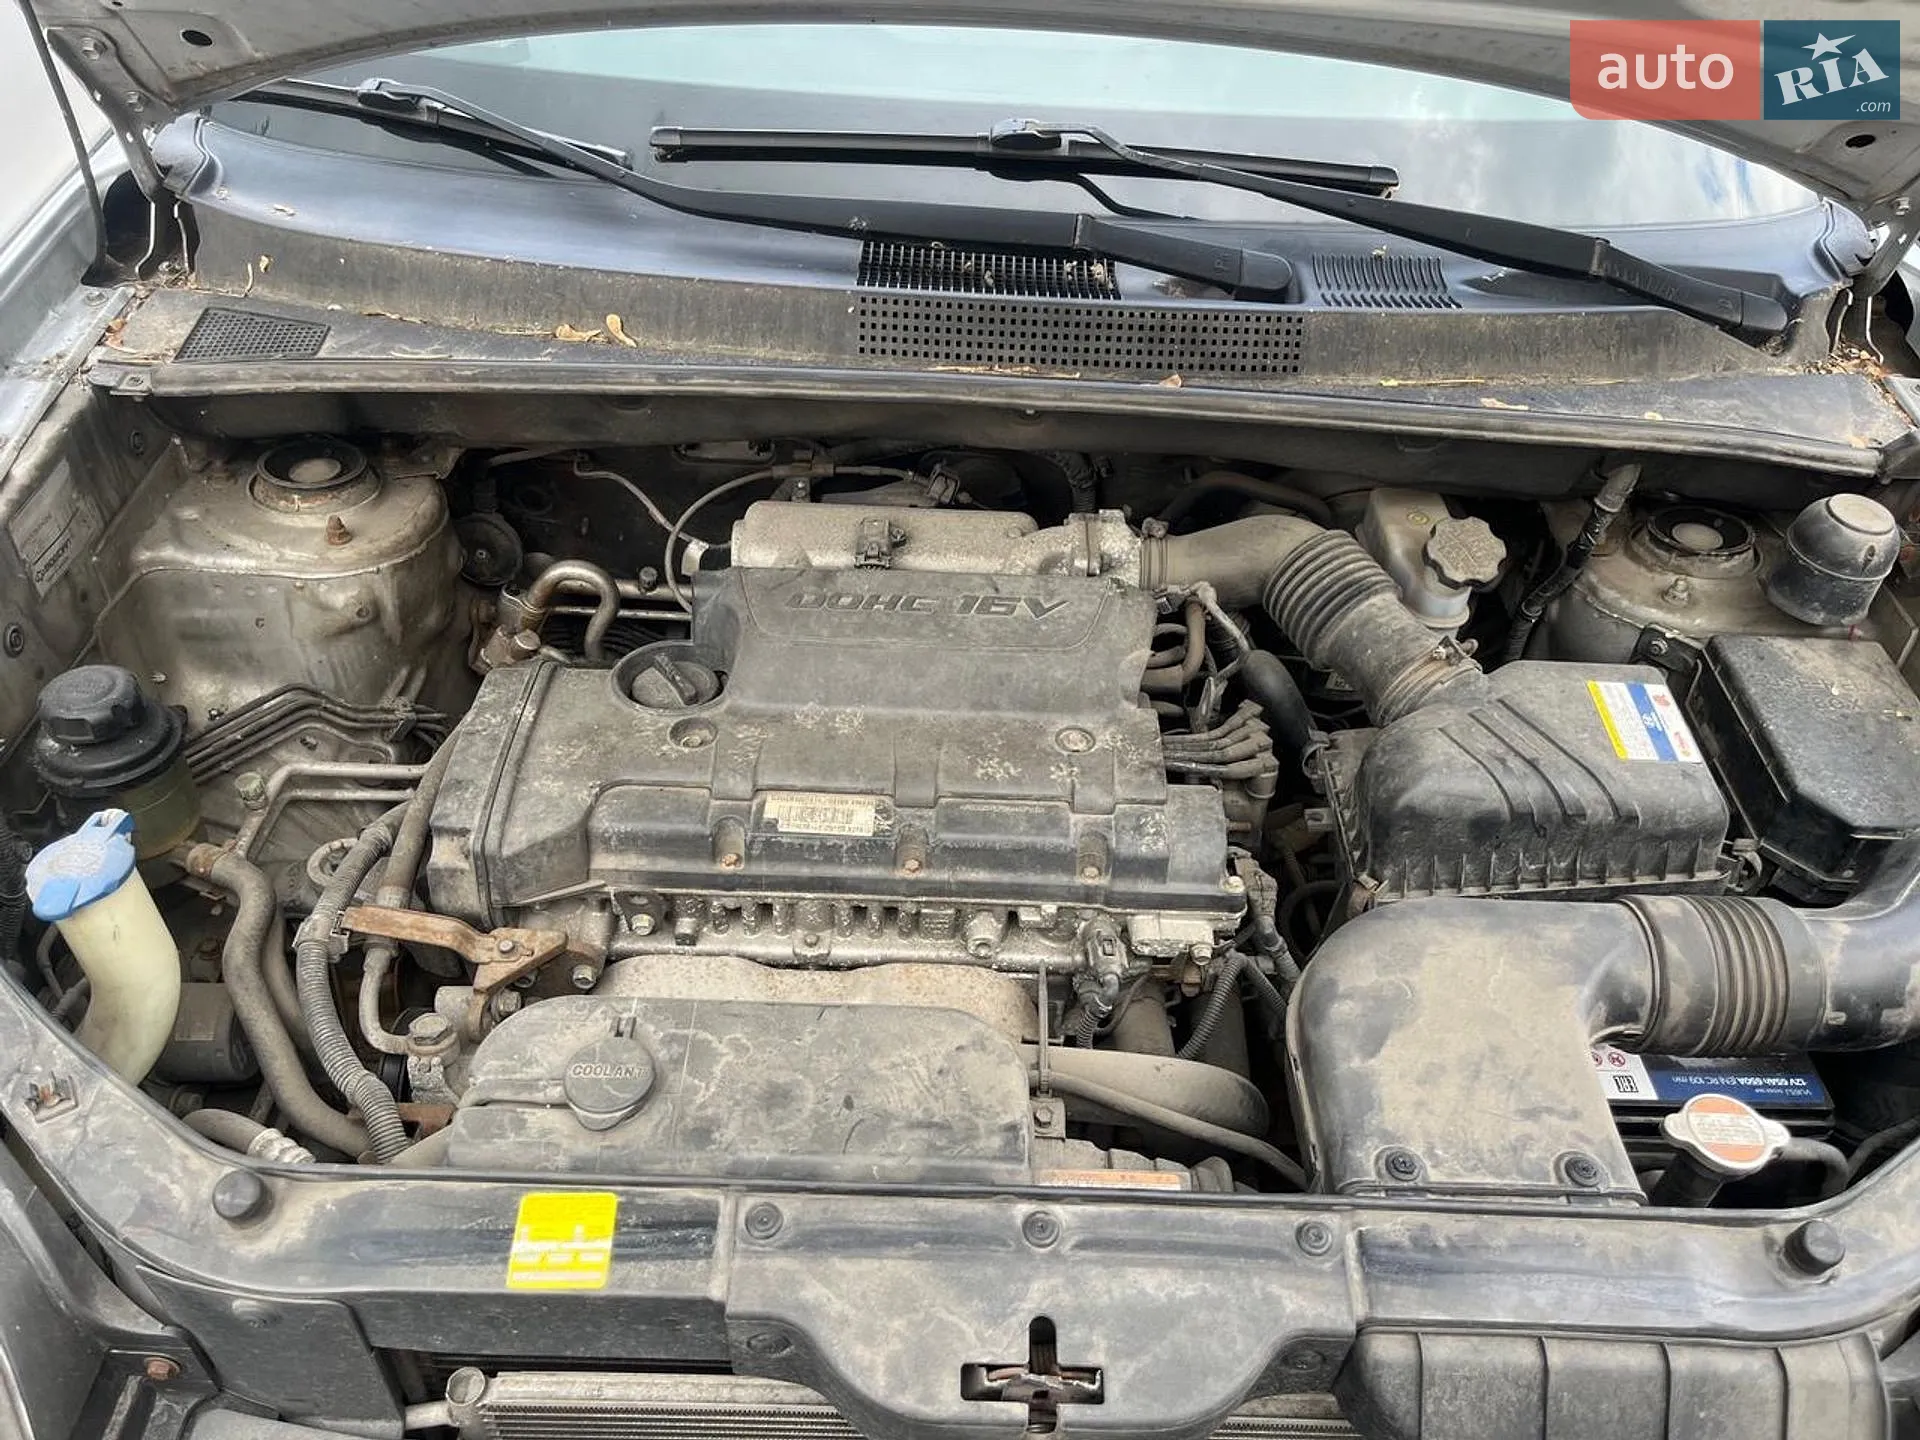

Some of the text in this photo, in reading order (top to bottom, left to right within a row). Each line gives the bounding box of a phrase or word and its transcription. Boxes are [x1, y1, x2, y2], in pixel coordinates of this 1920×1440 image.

[786, 592, 1071, 620] DOHC 16V
[572, 1062, 649, 1079] COOLANT
